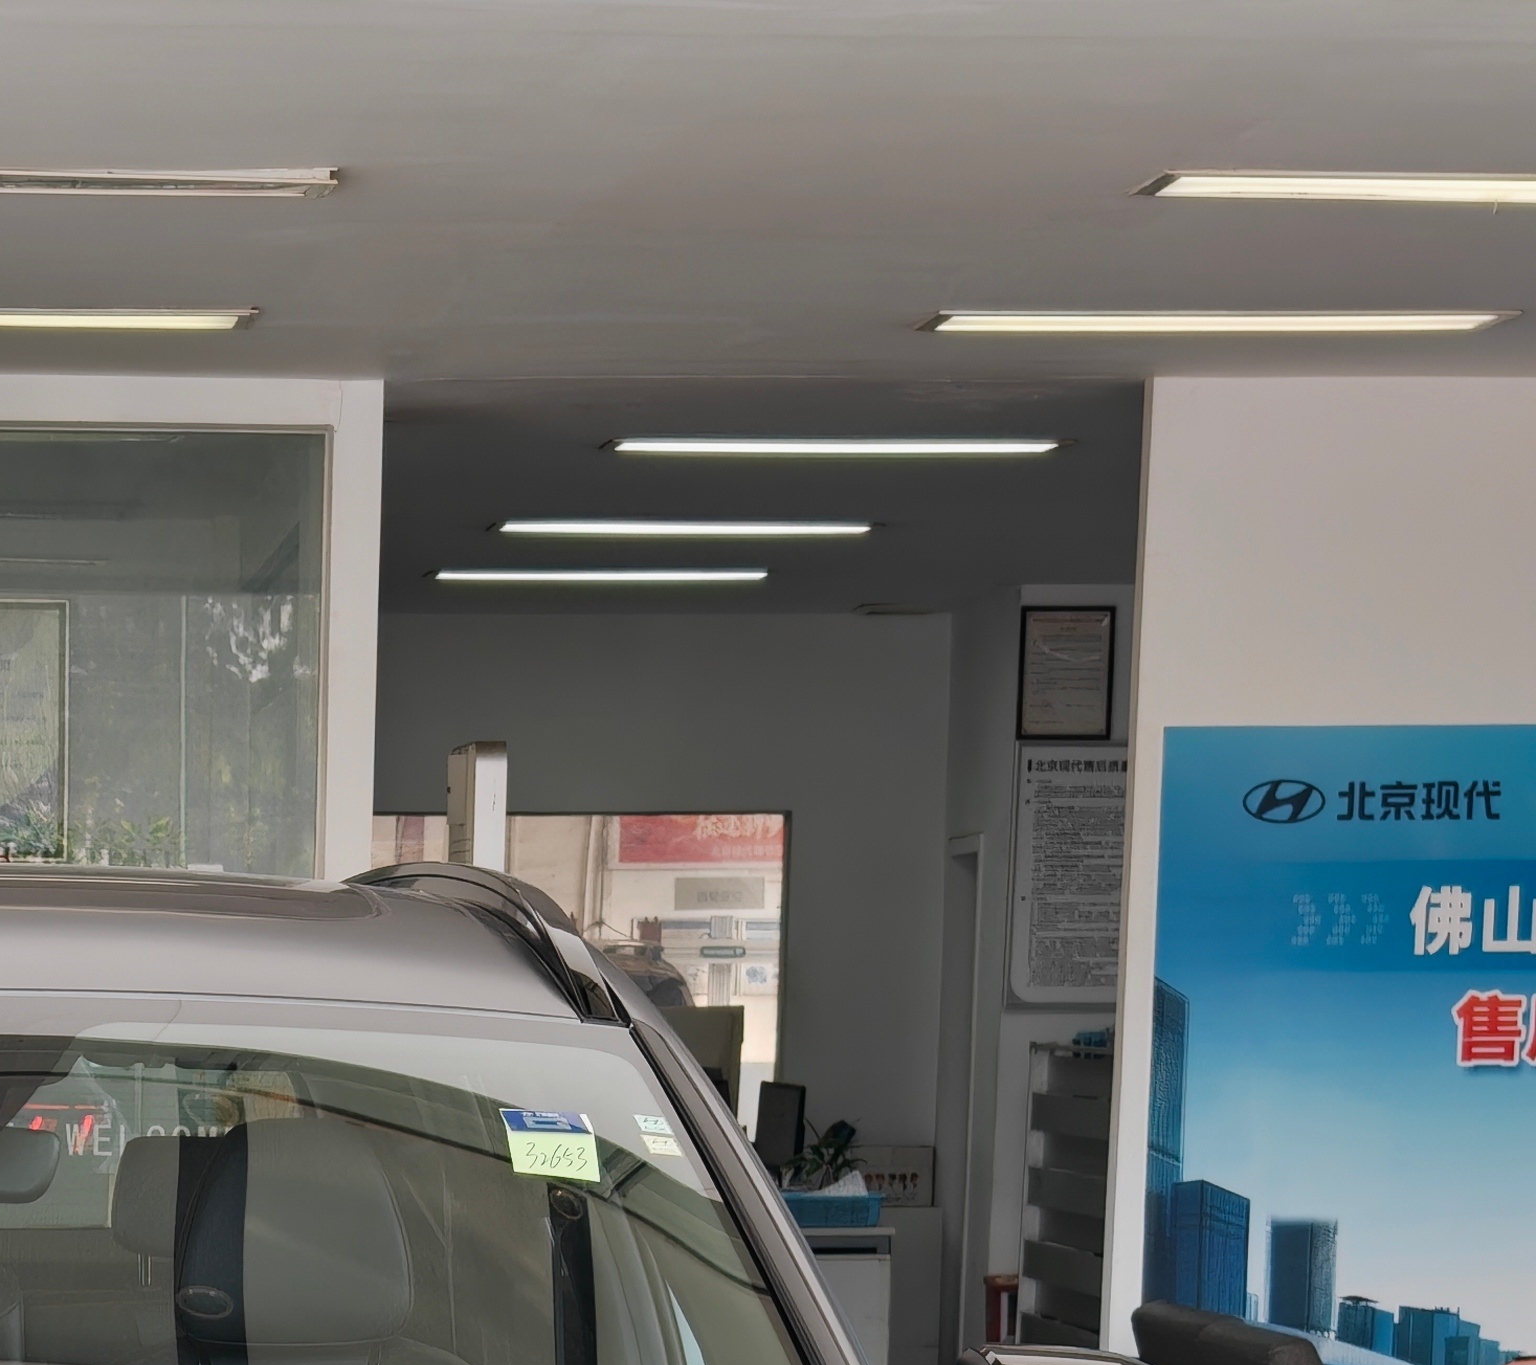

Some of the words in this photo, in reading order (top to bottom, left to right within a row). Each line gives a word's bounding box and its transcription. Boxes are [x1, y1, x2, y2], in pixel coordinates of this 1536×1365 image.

[1336, 780, 1502, 821] 北京现代
[1409, 885, 1536, 955] 佛山
[1452, 989, 1536, 1067] 售
